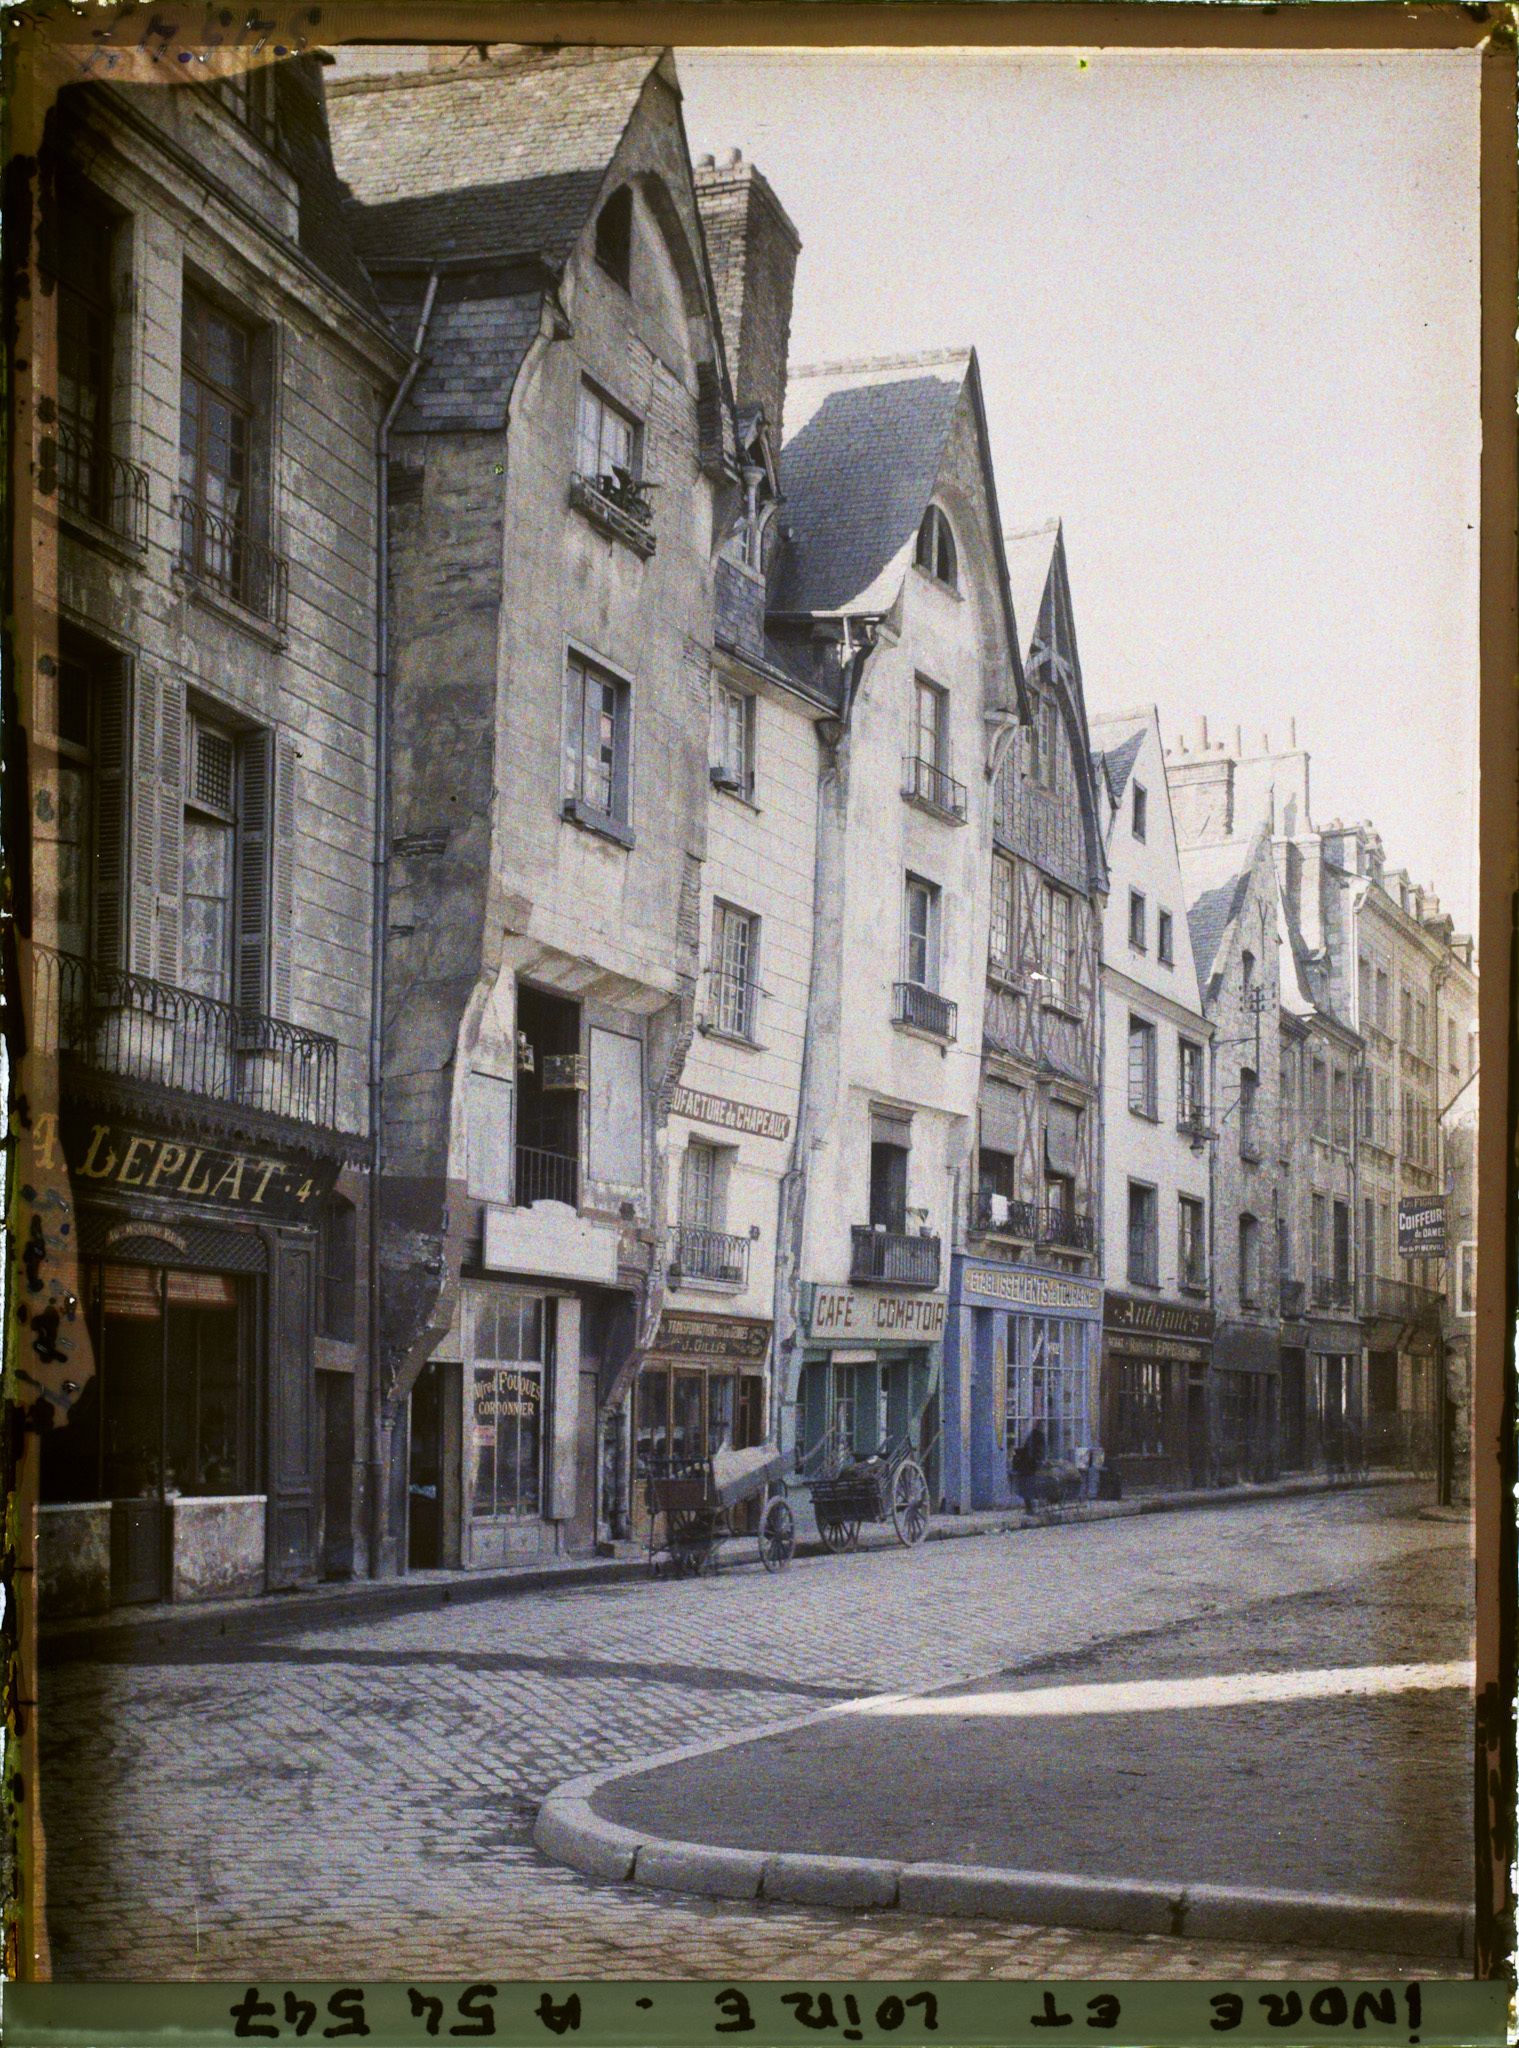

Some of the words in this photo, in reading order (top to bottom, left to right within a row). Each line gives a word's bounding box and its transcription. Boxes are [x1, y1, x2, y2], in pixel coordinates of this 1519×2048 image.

[736, 1105, 787, 1139] CHAPEAUX
[75, 1124, 288, 1203] LEPLAT
[876, 1297, 945, 1331] COMPTOIR
